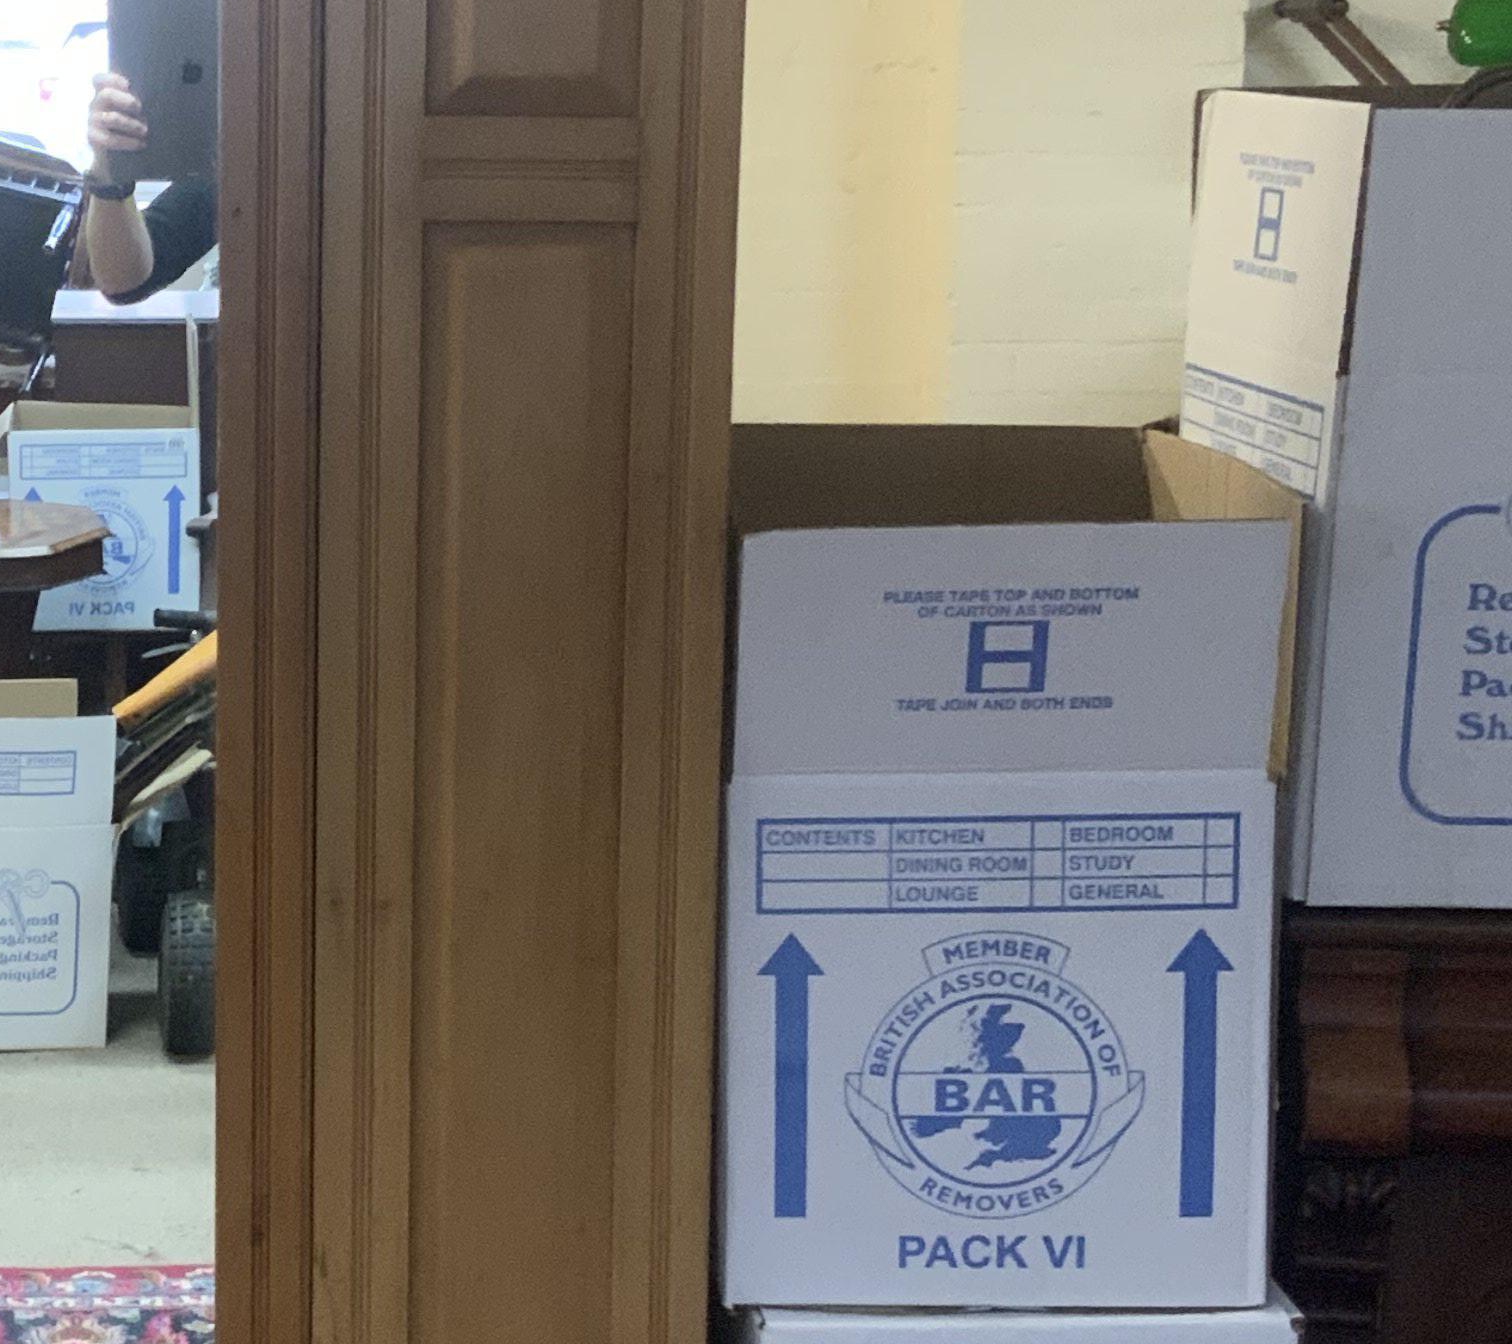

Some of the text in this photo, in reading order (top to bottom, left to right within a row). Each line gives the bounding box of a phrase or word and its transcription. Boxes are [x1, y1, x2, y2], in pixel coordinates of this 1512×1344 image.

[883, 586, 1141, 604] PLEASE TAPE TOP AND BOTTOM
[917, 603, 1103, 619] OF CARTON AS SHOWN
[897, 696, 1114, 711] TAPE JOIN AND BOTH ENDS
[766, 828, 877, 847] CONTENTS
[895, 827, 984, 846] KITCHEN
[1069, 826, 1174, 844] BEDROOM
[895, 855, 1027, 873] DINING ROOM
[1069, 855, 1135, 872] STUDY
[895, 885, 978, 903] LOUNGE
[1069, 884, 1164, 901] GENERAL
[942, 939, 1052, 964] MEMBER
[869, 969, 1122, 1078] BRITISH ASSOCIATION OF
[934, 1078, 1057, 1113] BAR
[919, 1177, 1065, 1212] REMOVERS
[898, 1235, 1086, 1270] PACK VI
